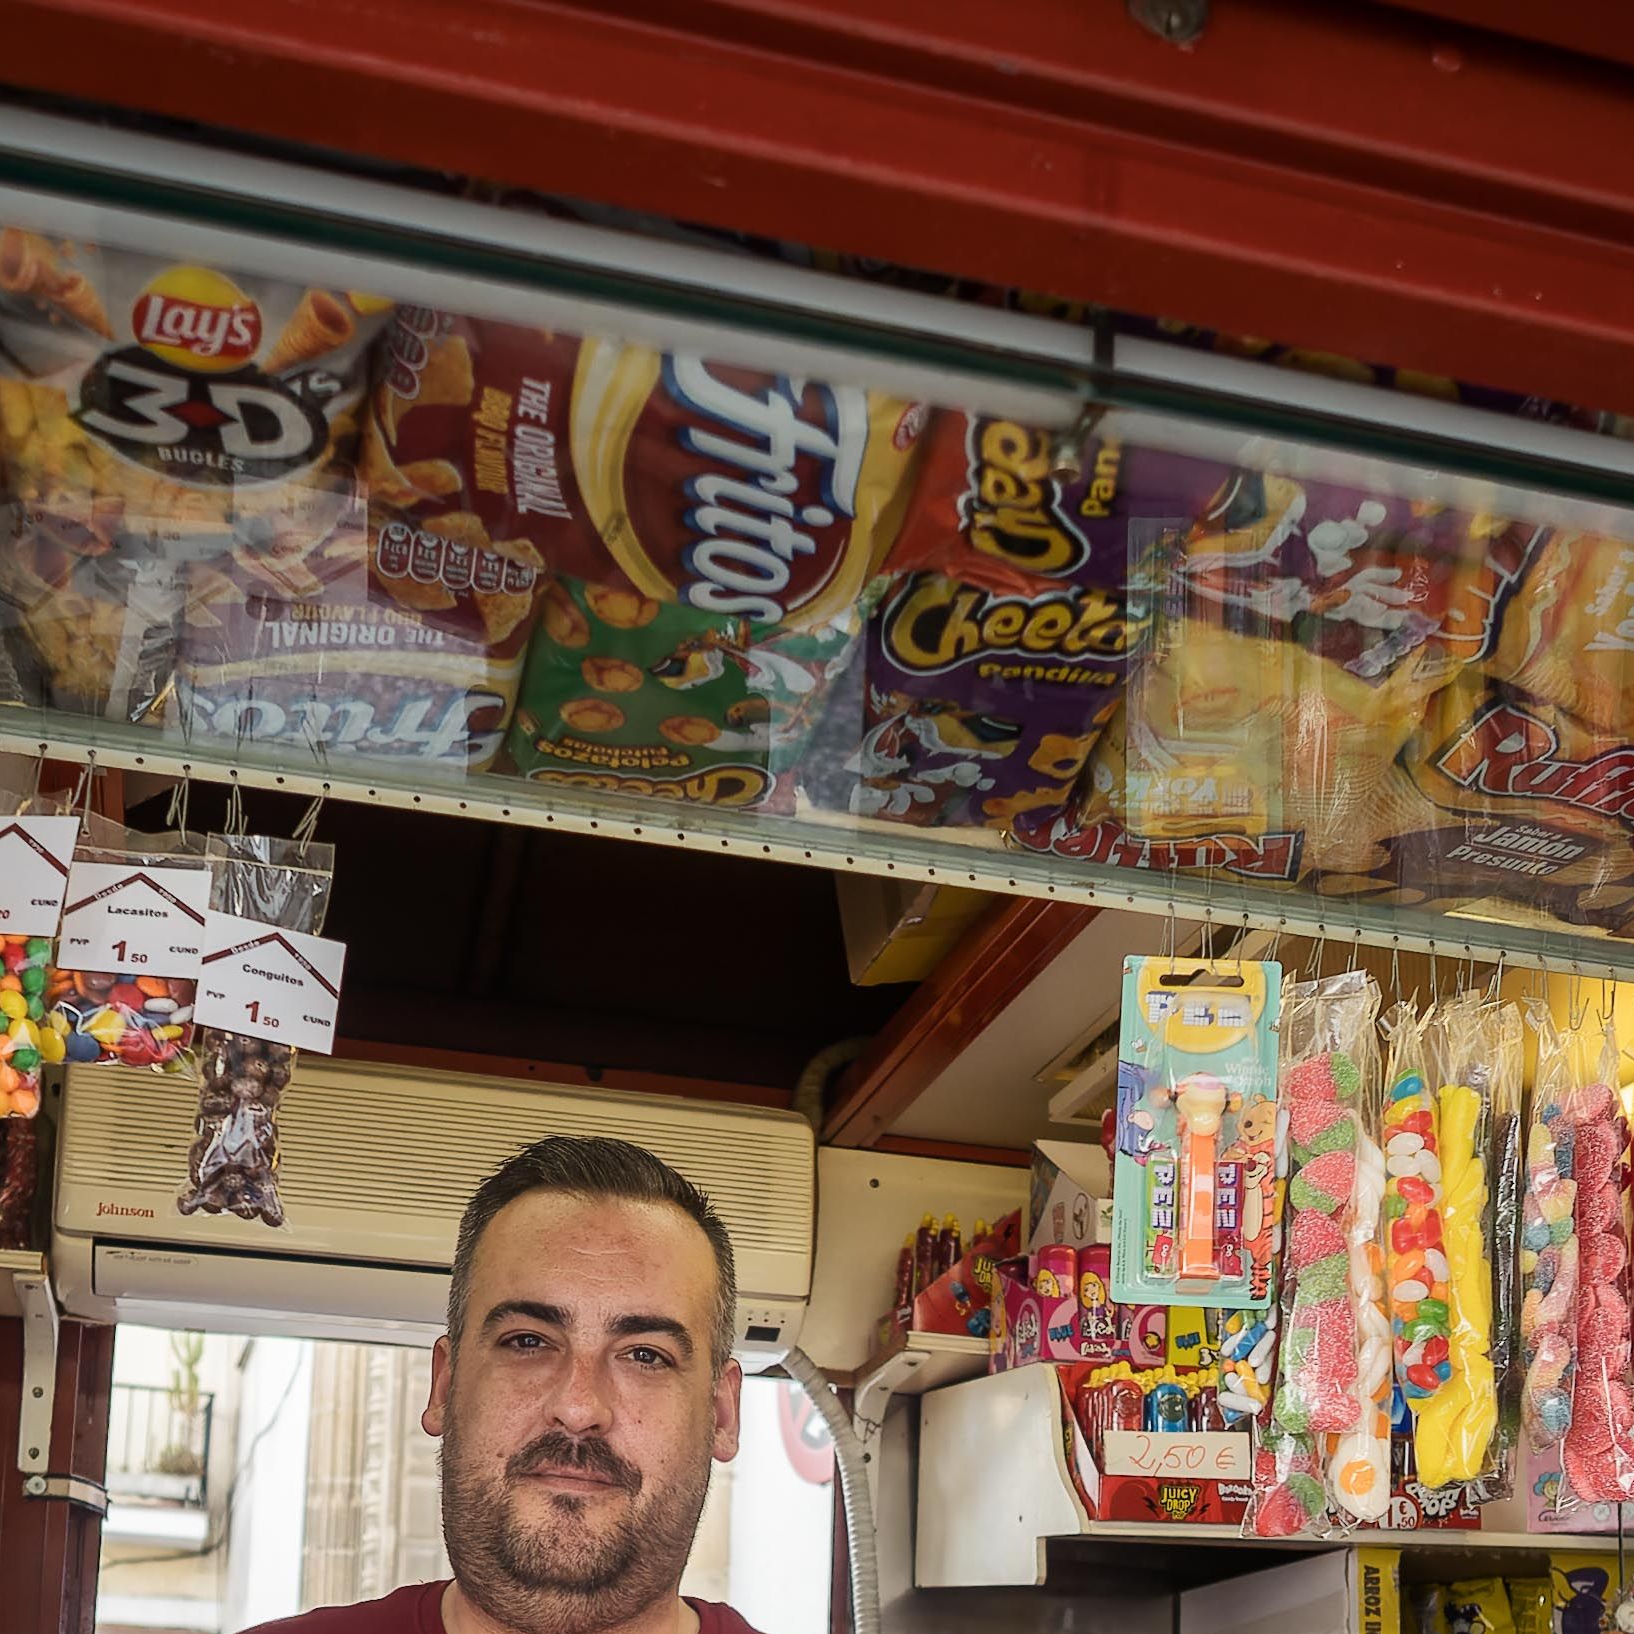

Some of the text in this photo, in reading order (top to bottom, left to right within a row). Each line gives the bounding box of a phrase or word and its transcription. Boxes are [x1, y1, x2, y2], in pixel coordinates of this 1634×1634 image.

[138, 293, 256, 357] Lay's
[157, 445, 245, 474] BUGLES
[505, 376, 572, 521] THE ORIGINAL
[107, 904, 168, 919] Lacasitos
[112, 940, 147, 964] 1 50
[242, 964, 304, 987] Conguitos
[245, 1000, 280, 1029] 1 50
[95, 1198, 155, 1221] johnson
[1160, 1485, 1199, 1502] JUICY
[1364, 1565, 1381, 1618] ARROZ
